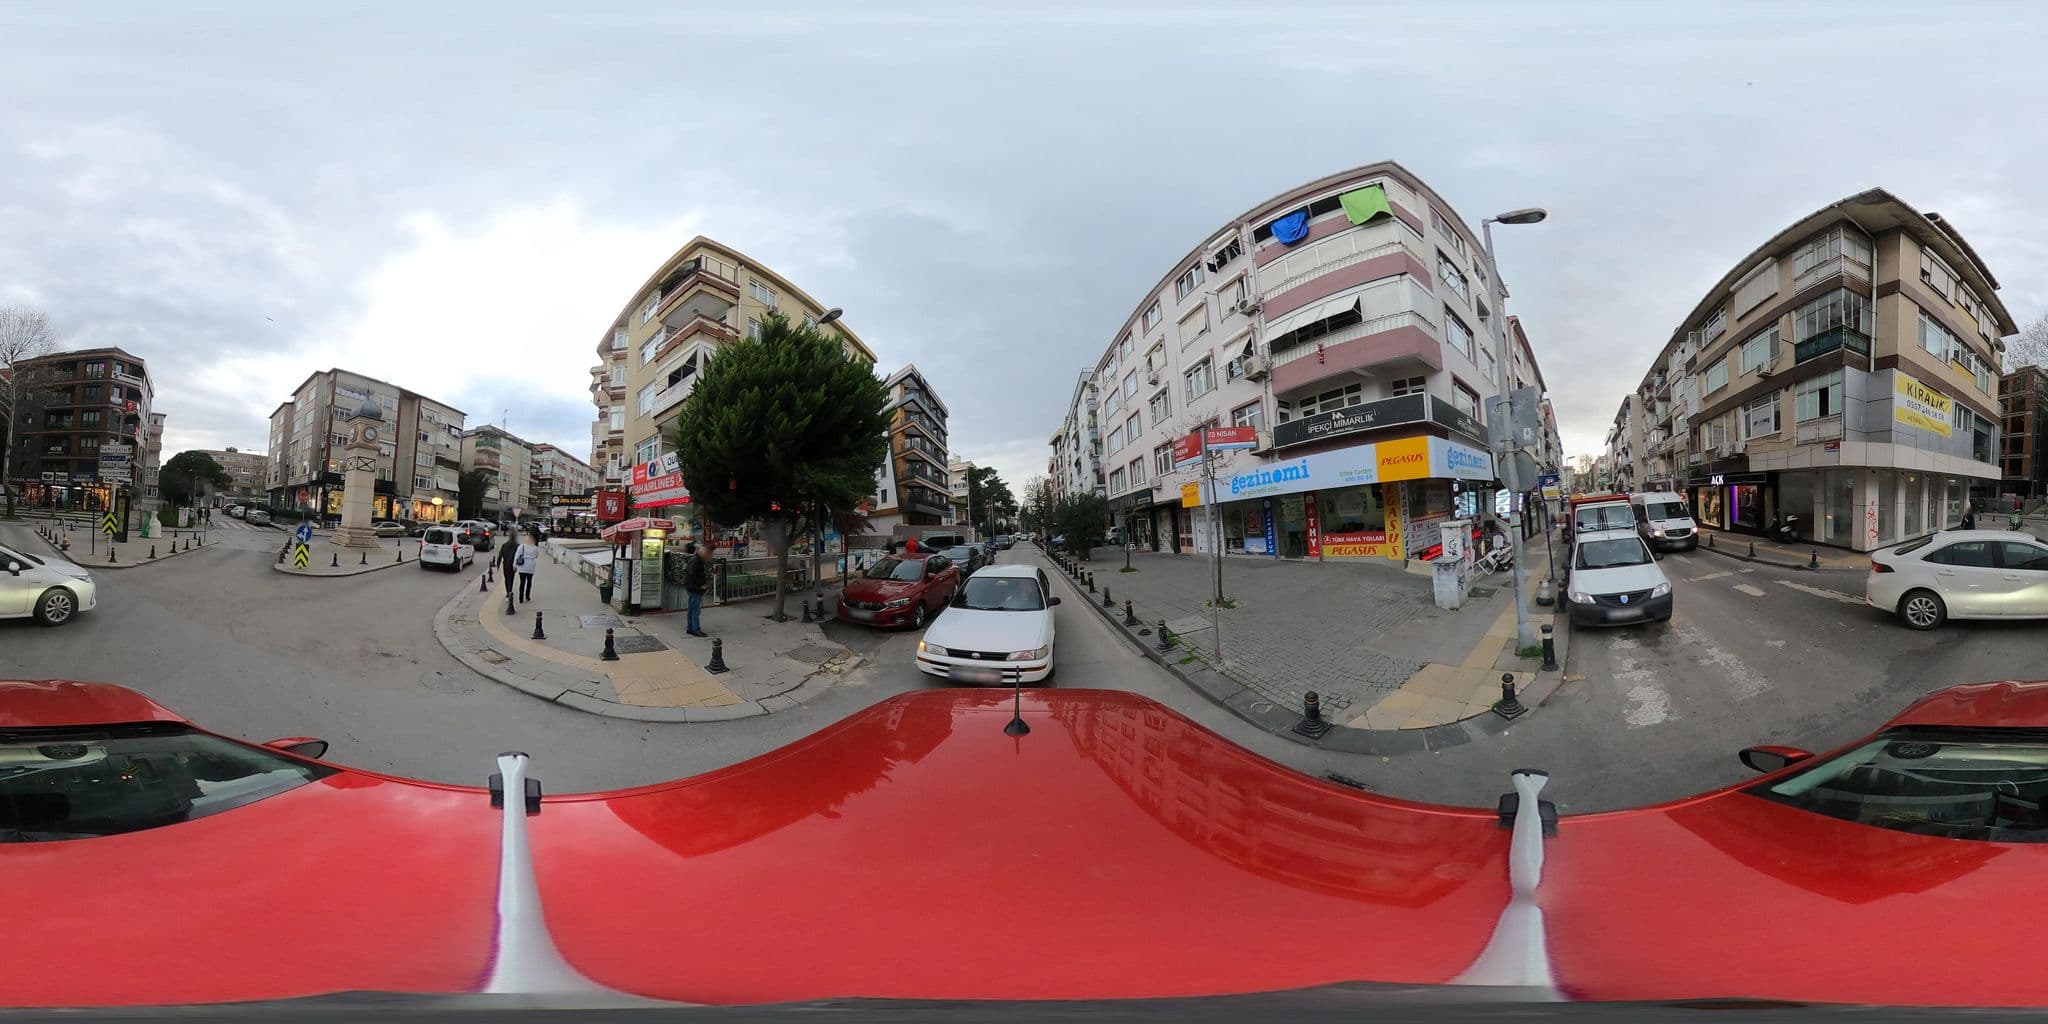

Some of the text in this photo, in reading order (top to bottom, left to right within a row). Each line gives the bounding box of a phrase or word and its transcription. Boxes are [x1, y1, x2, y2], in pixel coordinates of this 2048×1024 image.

[1907, 383, 1945, 411] KİRALIK
[1382, 454, 1424, 465] PEGASUS
[1231, 459, 1310, 494] gezinomi
[1308, 518, 1317, 547] THY
[1332, 546, 1377, 556] PEGASUS
